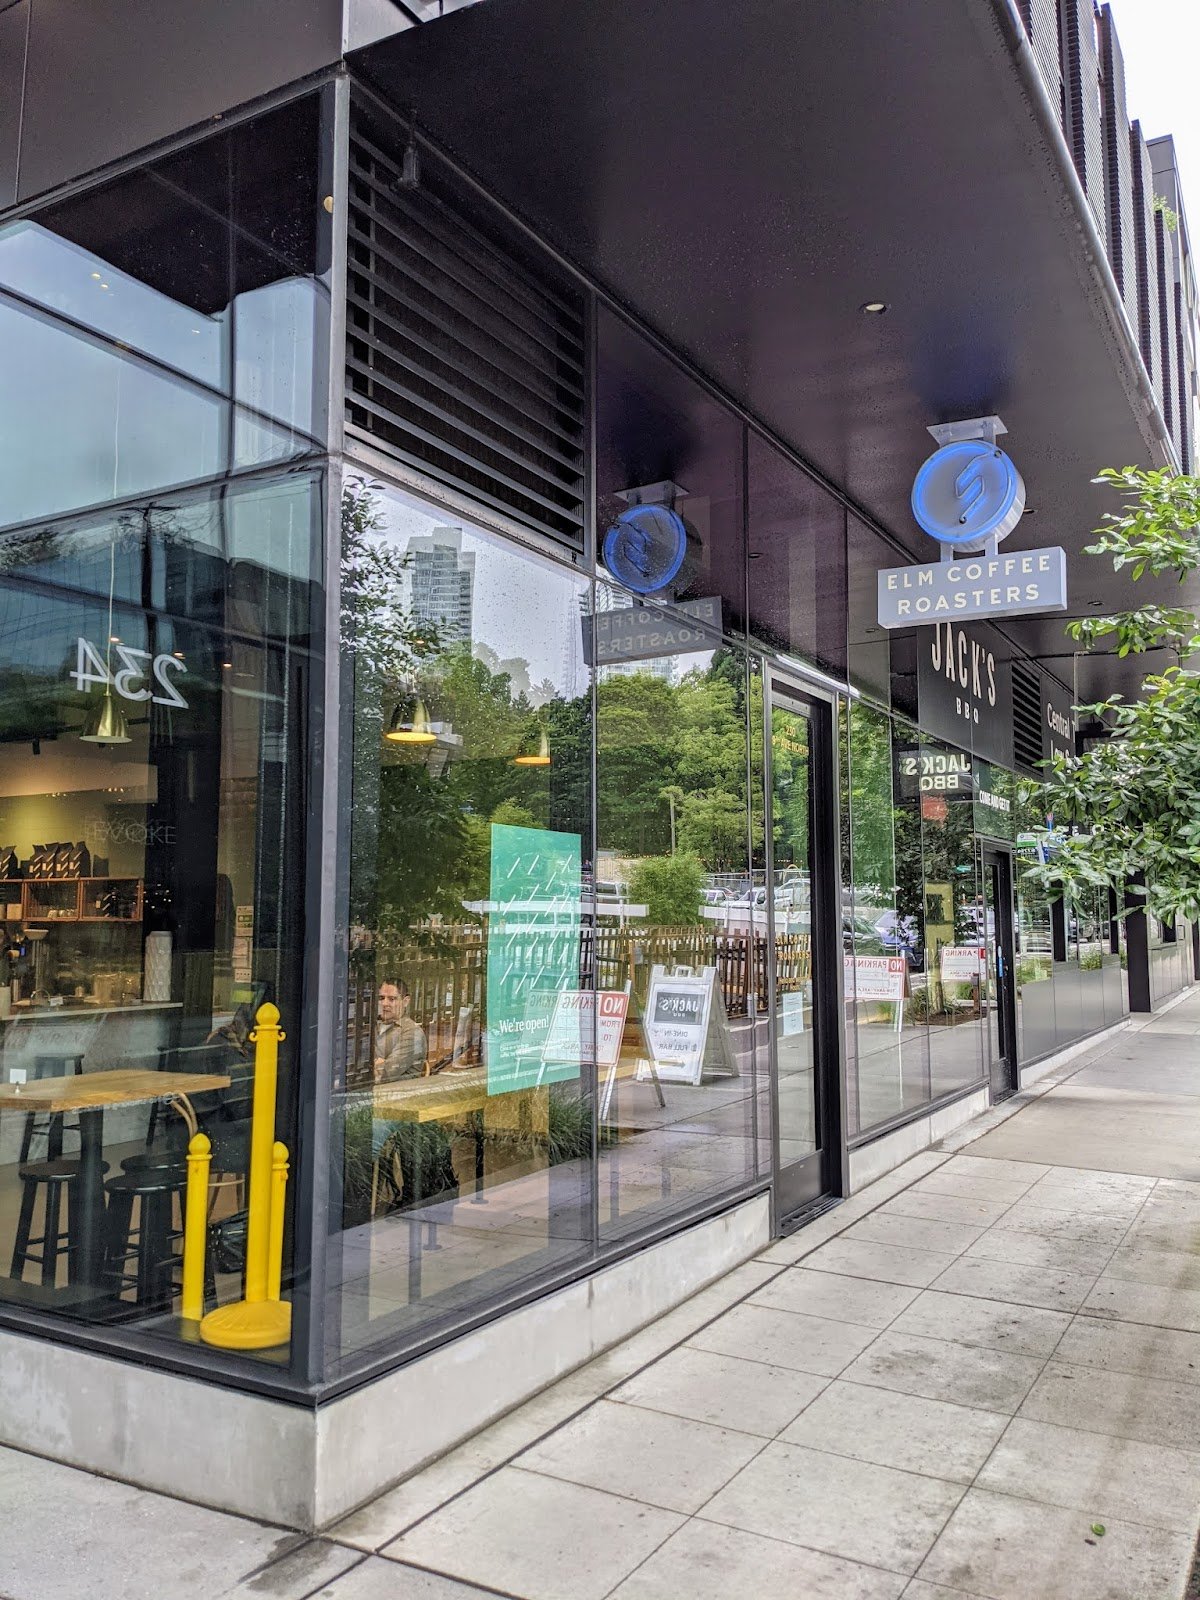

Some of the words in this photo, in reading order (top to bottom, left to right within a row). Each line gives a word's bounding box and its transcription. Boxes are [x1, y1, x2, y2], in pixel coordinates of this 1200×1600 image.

[887, 569, 934, 590] ELM
[947, 554, 1050, 582] COFFEE
[897, 583, 1040, 615] ROASTERS
[931, 622, 996, 707] JACK'S
[956, 697, 979, 724] BBQ
[1046, 702, 1071, 740] Central
[499, 1017, 525, 1033] We're
[525, 1015, 549, 1034] open!
